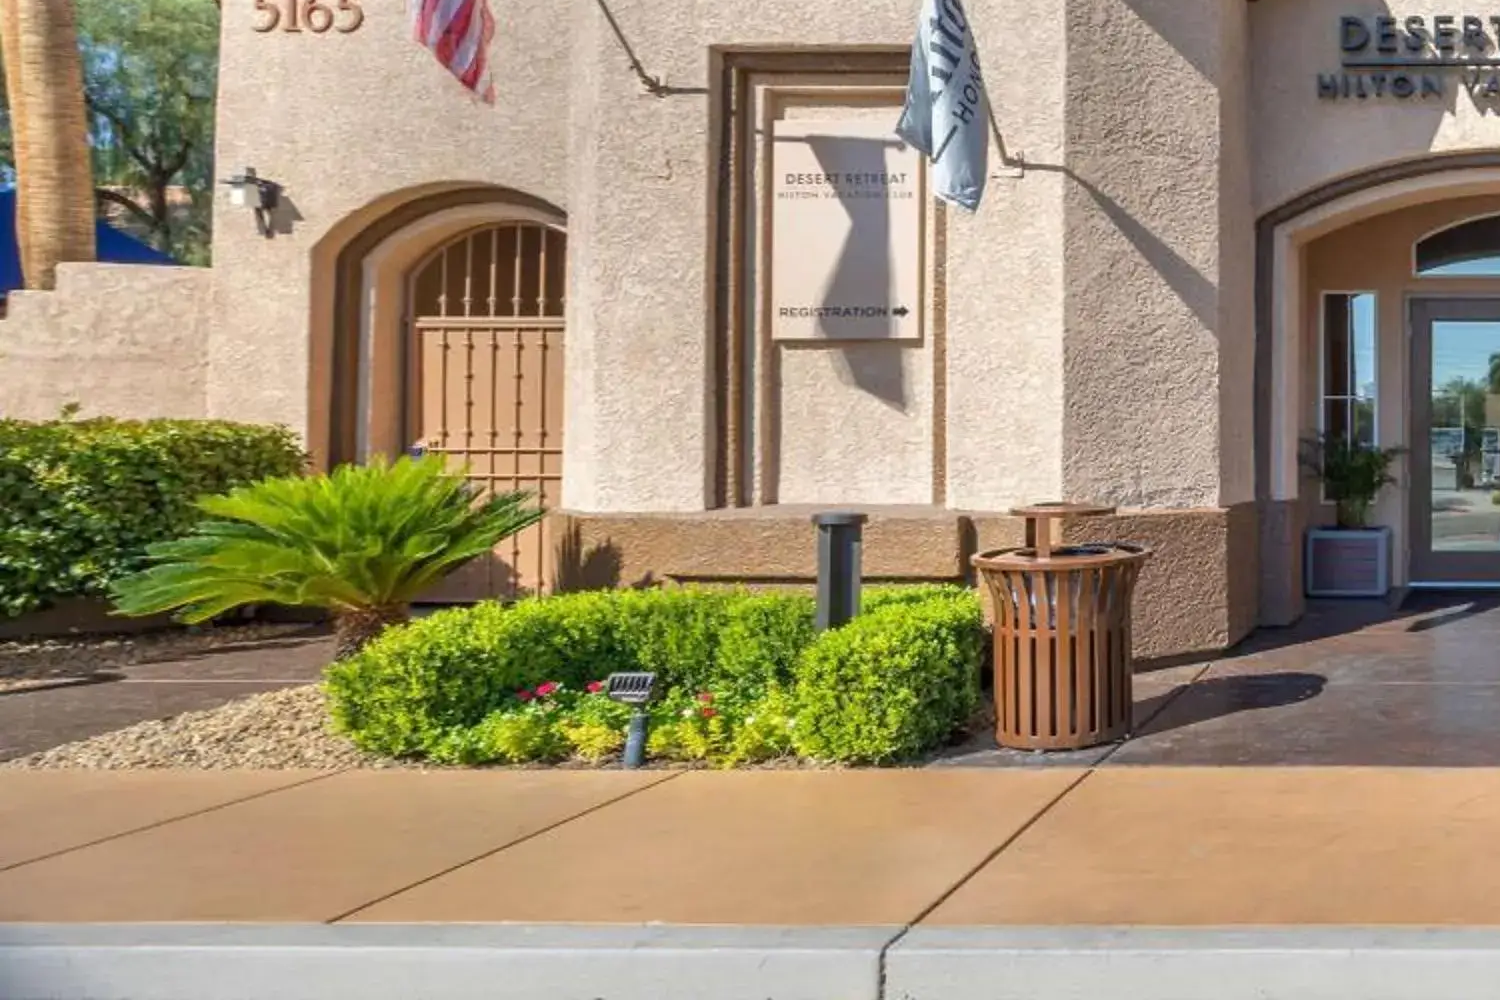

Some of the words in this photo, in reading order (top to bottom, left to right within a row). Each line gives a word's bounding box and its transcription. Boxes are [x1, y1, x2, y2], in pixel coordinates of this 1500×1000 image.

[1317, 73, 1442, 99] HILTON
[785, 172, 840, 185] DESERT
[845, 172, 907, 185] RETREAT
[779, 306, 888, 318] REGISTRATION
